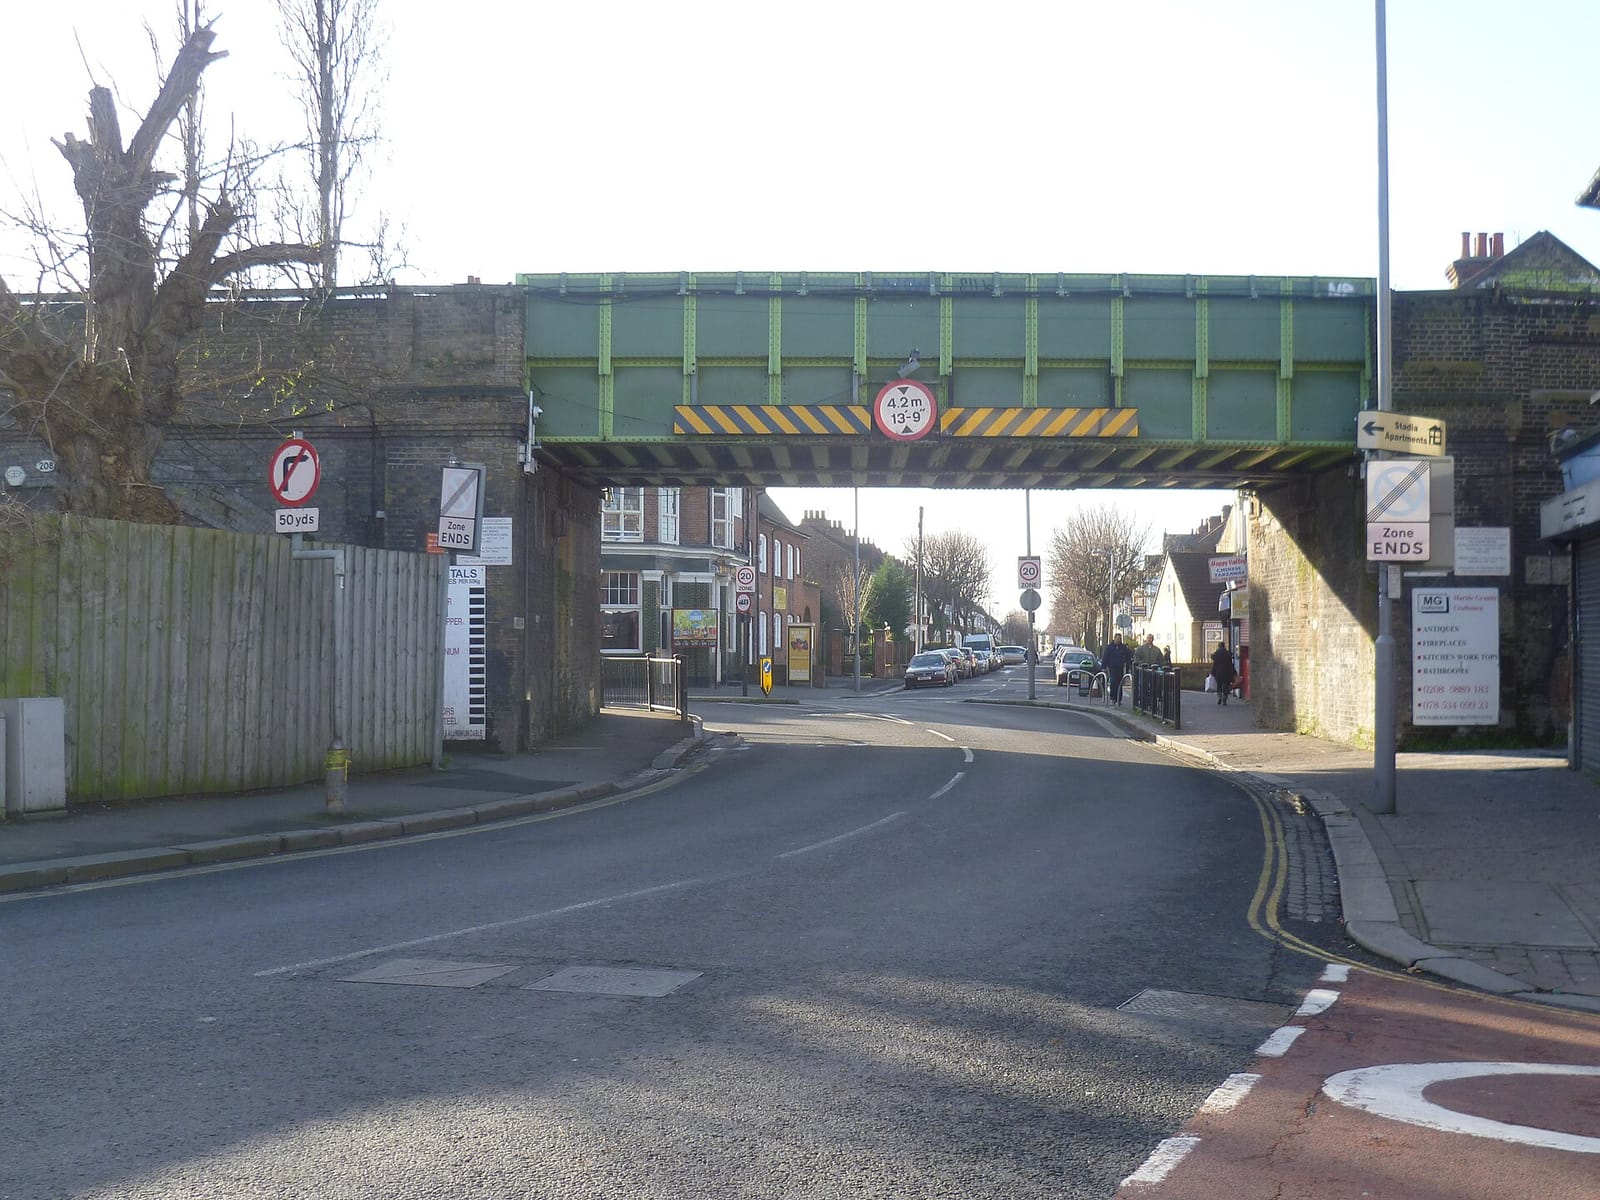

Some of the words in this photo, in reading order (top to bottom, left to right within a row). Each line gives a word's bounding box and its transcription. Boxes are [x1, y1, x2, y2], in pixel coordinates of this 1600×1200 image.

[1394, 421, 1418, 433] Stadia
[1384, 431, 1427, 446] Apartments
[279, 514, 294, 526] 50
[295, 513, 315, 527] yds
[447, 521, 466, 531] Zone
[1382, 527, 1414, 538] Zone
[441, 532, 470, 545] ENDS
[1373, 542, 1423, 555] ENDS
[450, 568, 478, 579] TALS
[740, 572, 752, 581] 20
[1022, 567, 1036, 576] 20
[1423, 595, 1442, 606] MG
[1423, 625, 1460, 634] ANTIQUES
[1423, 640, 1467, 648] FIREPLACES
[1423, 667, 1469, 675] BATHROOMS
